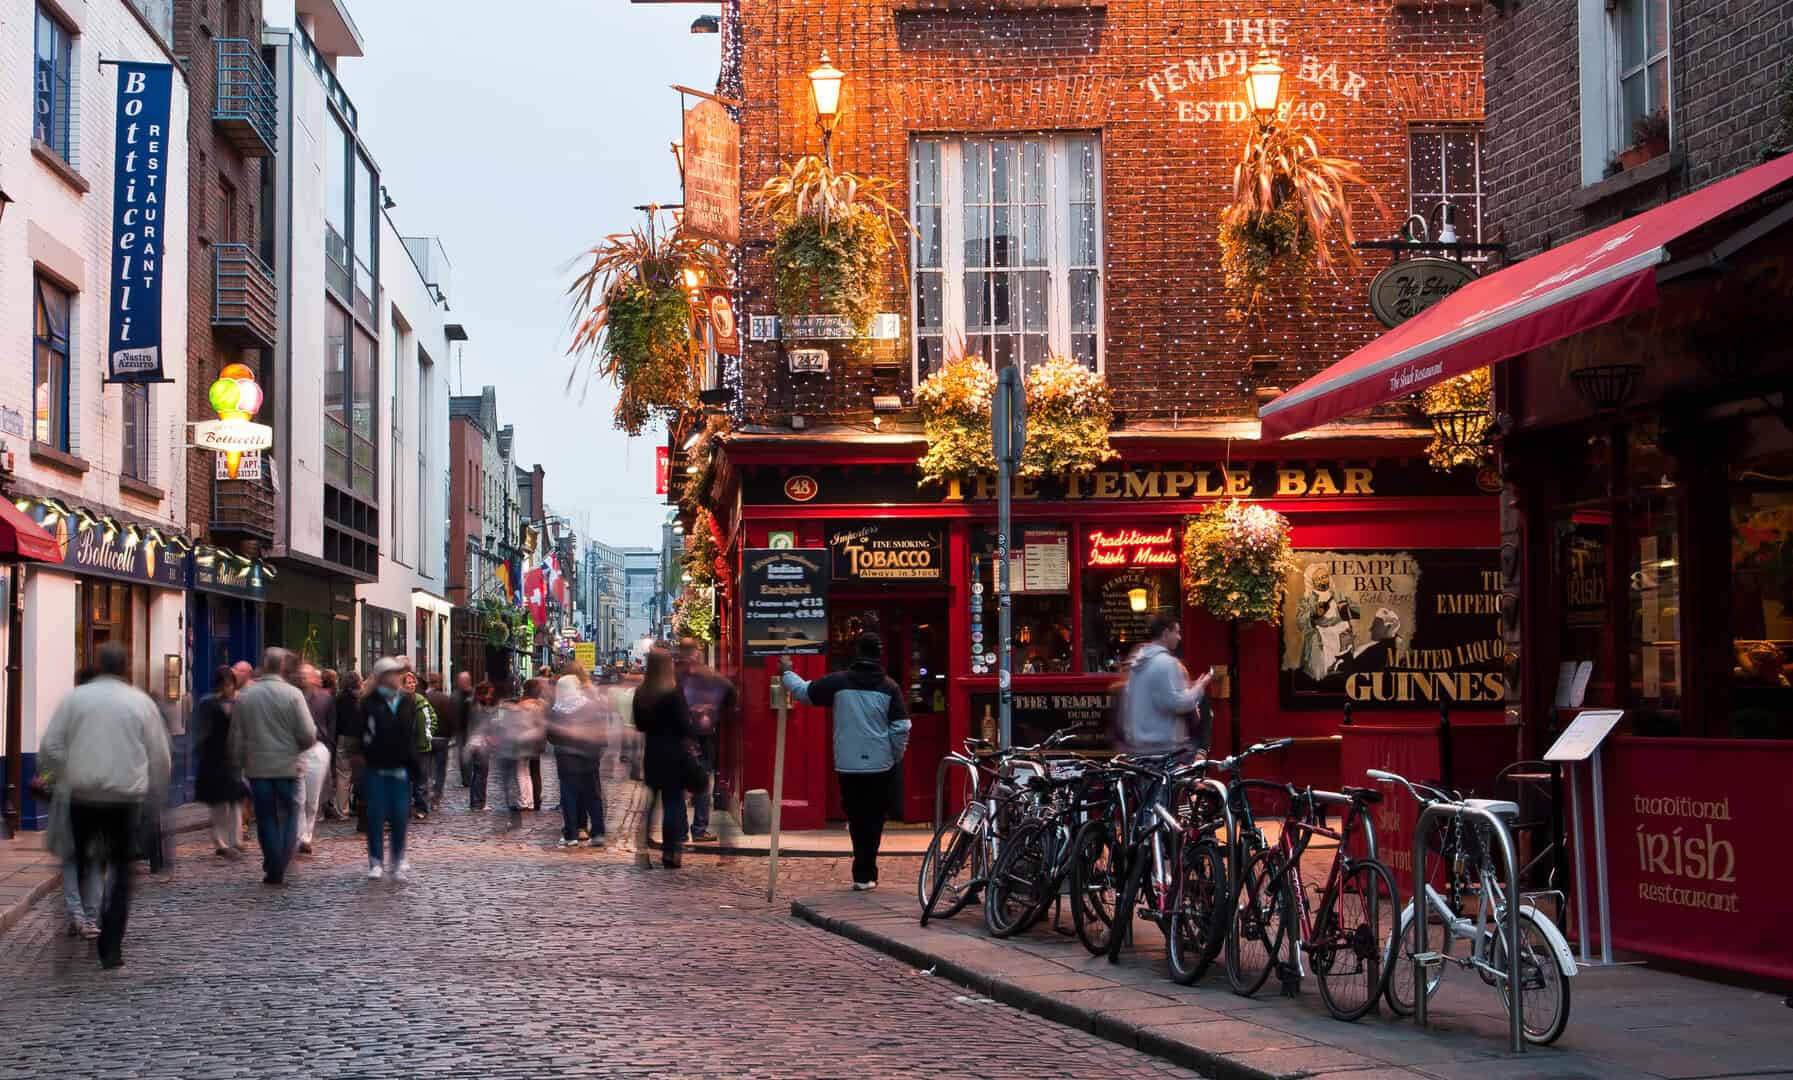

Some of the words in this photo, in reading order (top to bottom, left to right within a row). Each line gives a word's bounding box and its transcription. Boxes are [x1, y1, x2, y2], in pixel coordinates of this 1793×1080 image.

[1218, 18, 1287, 46] THE
[1139, 49, 1281, 102] TEMPL
[1297, 54, 1367, 102] BAR
[120, 72, 146, 341] Botticelli
[143, 125, 160, 289] RESTAURANT
[205, 431, 265, 444] Botticelli
[790, 479, 811, 494] 48
[1065, 470, 1253, 499] TEMPLE
[1276, 468, 1375, 496] BAR
[78, 527, 138, 573] Botticelli
[872, 540, 892, 549] FINE
[893, 540, 931, 549] SMOKING
[1089, 527, 1173, 547] Traditional
[842, 545, 931, 575] TOBACCO
[1087, 547, 1127, 566] Irish
[1132, 546, 1177, 563] Music
[1328, 559, 1415, 576] TEMPLE
[1354, 576, 1395, 593] BAR
[1385, 647, 1452, 670] MALTED
[1455, 638, 1505, 666] LIQUO
[1345, 671, 1505, 702] GUINNES
[1014, 695, 1048, 710] THE
